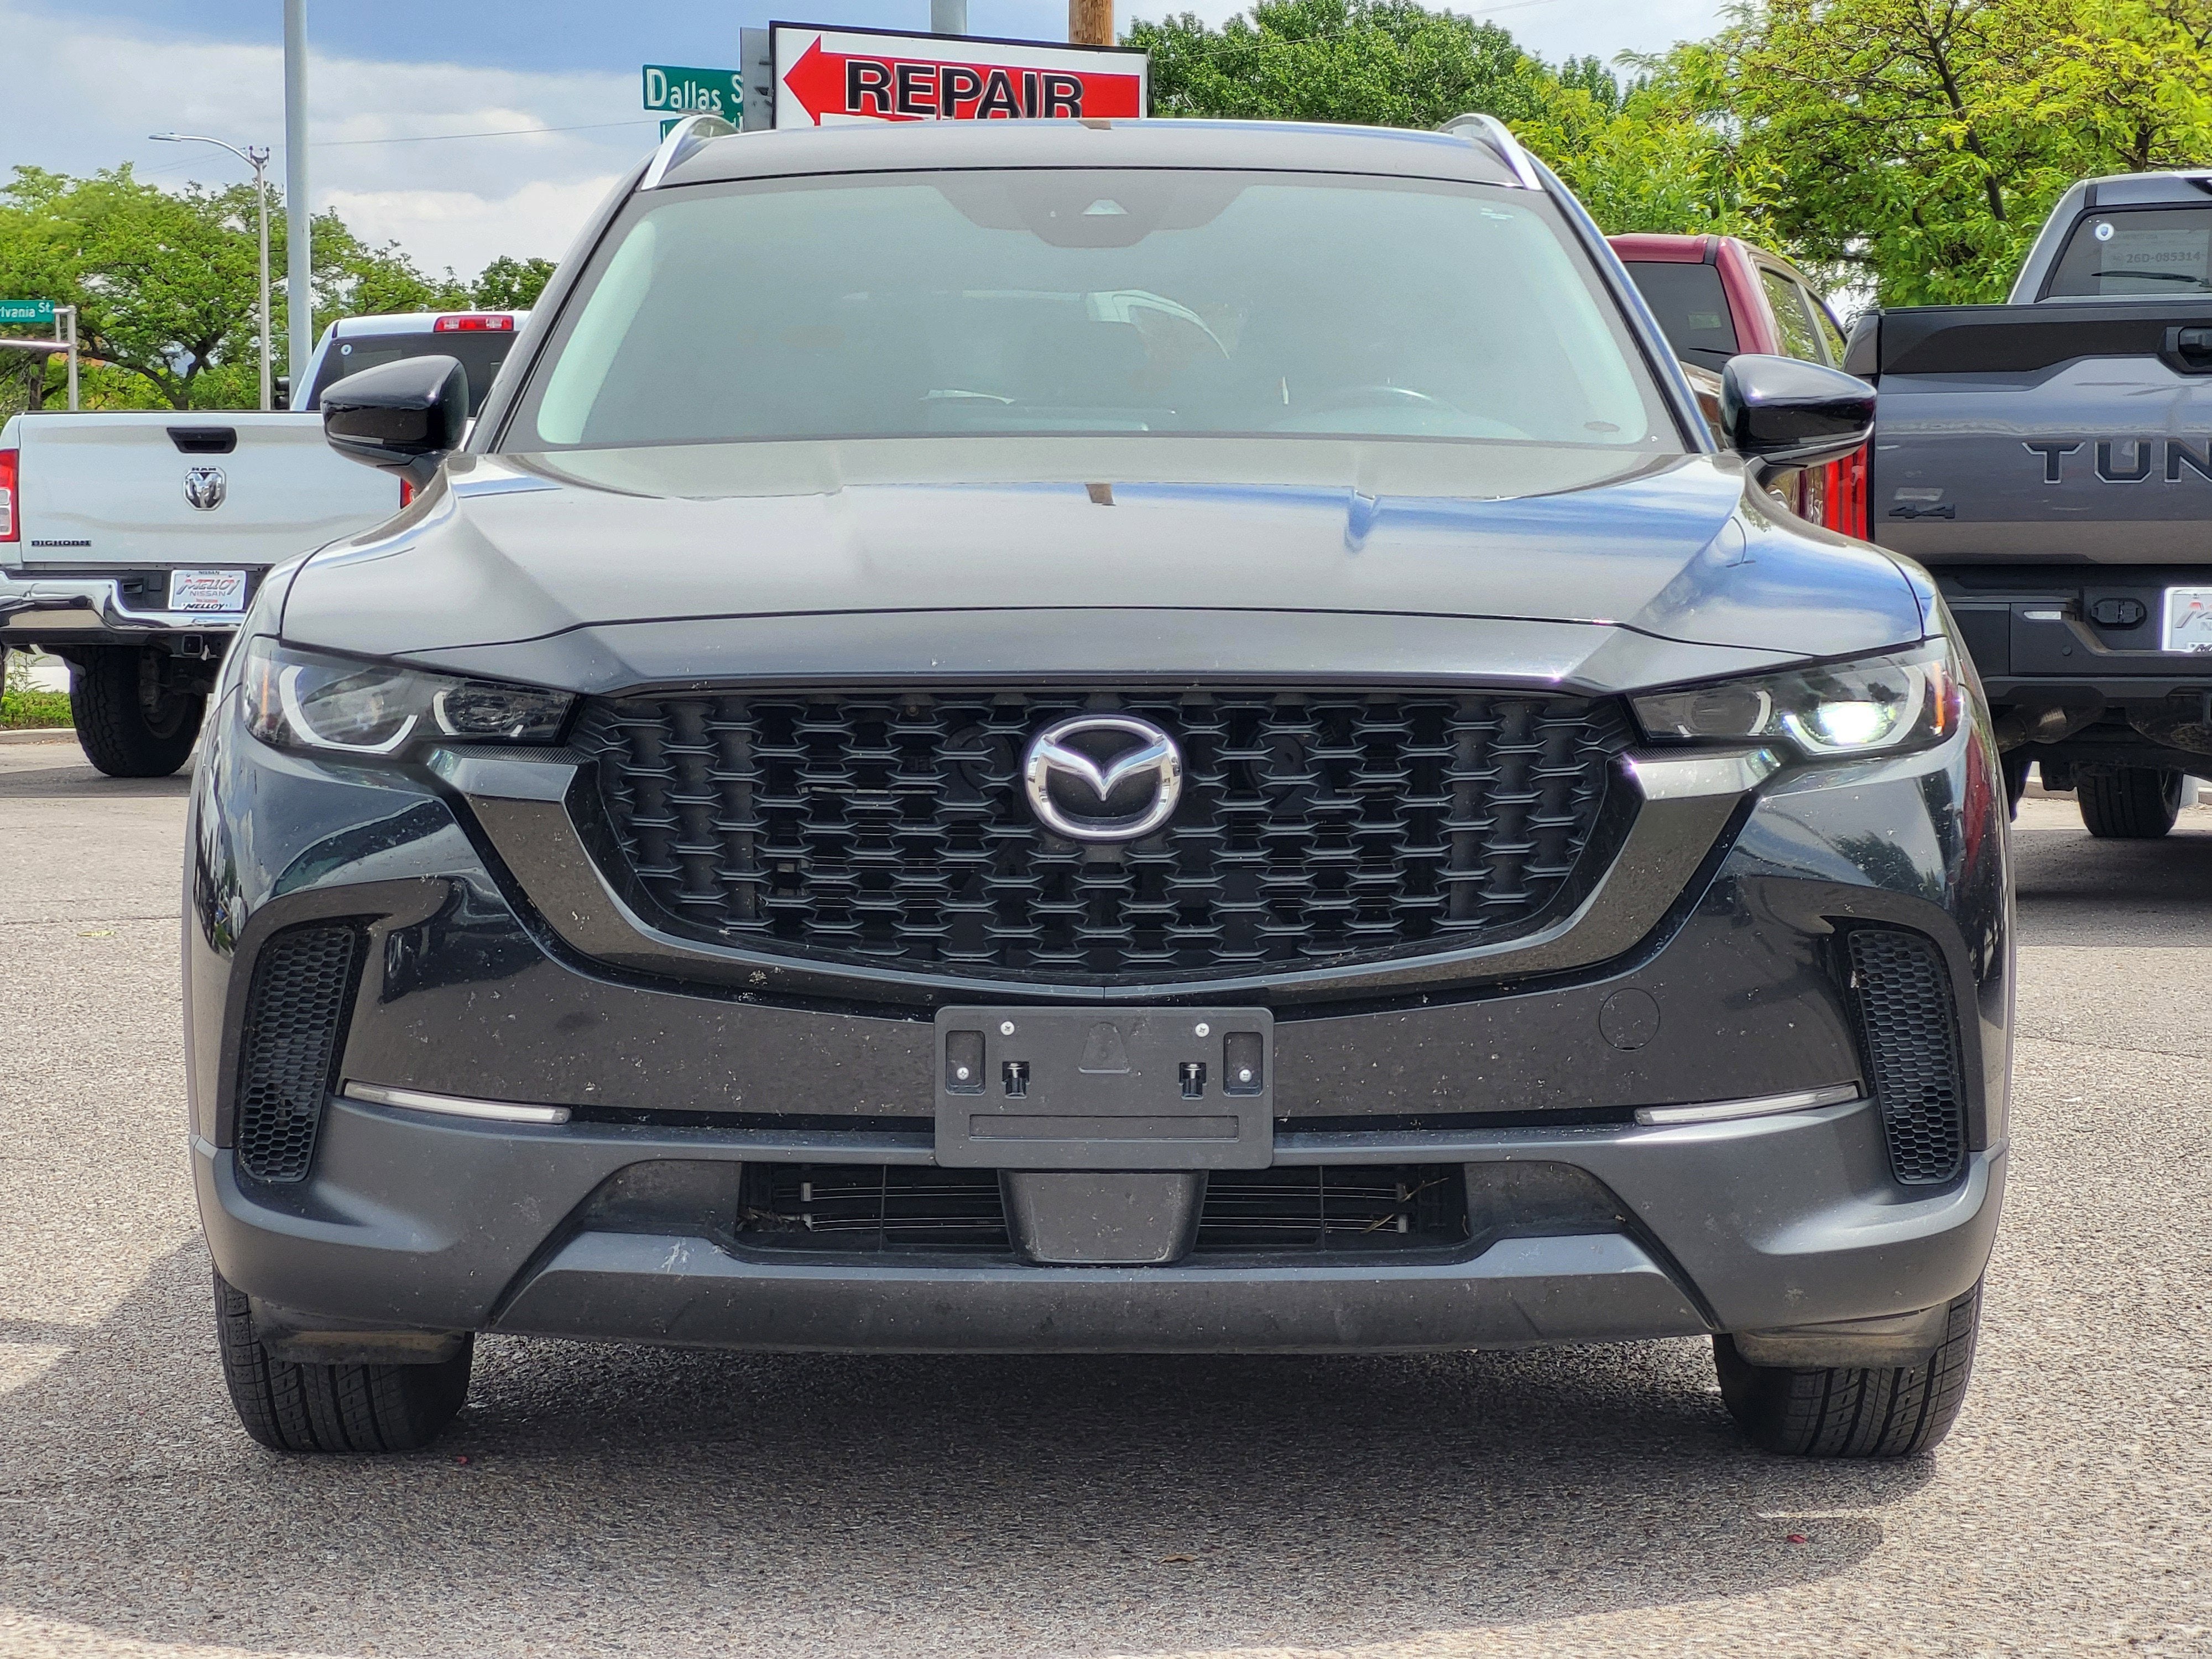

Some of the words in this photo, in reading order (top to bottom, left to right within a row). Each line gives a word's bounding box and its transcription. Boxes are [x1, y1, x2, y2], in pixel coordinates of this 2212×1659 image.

[646, 68, 722, 111] Dallas
[731, 74, 744, 103] S
[845, 59, 1084, 119] REPAIR
[38, 302, 50, 313] St
[2021, 439, 2212, 484] TUN
